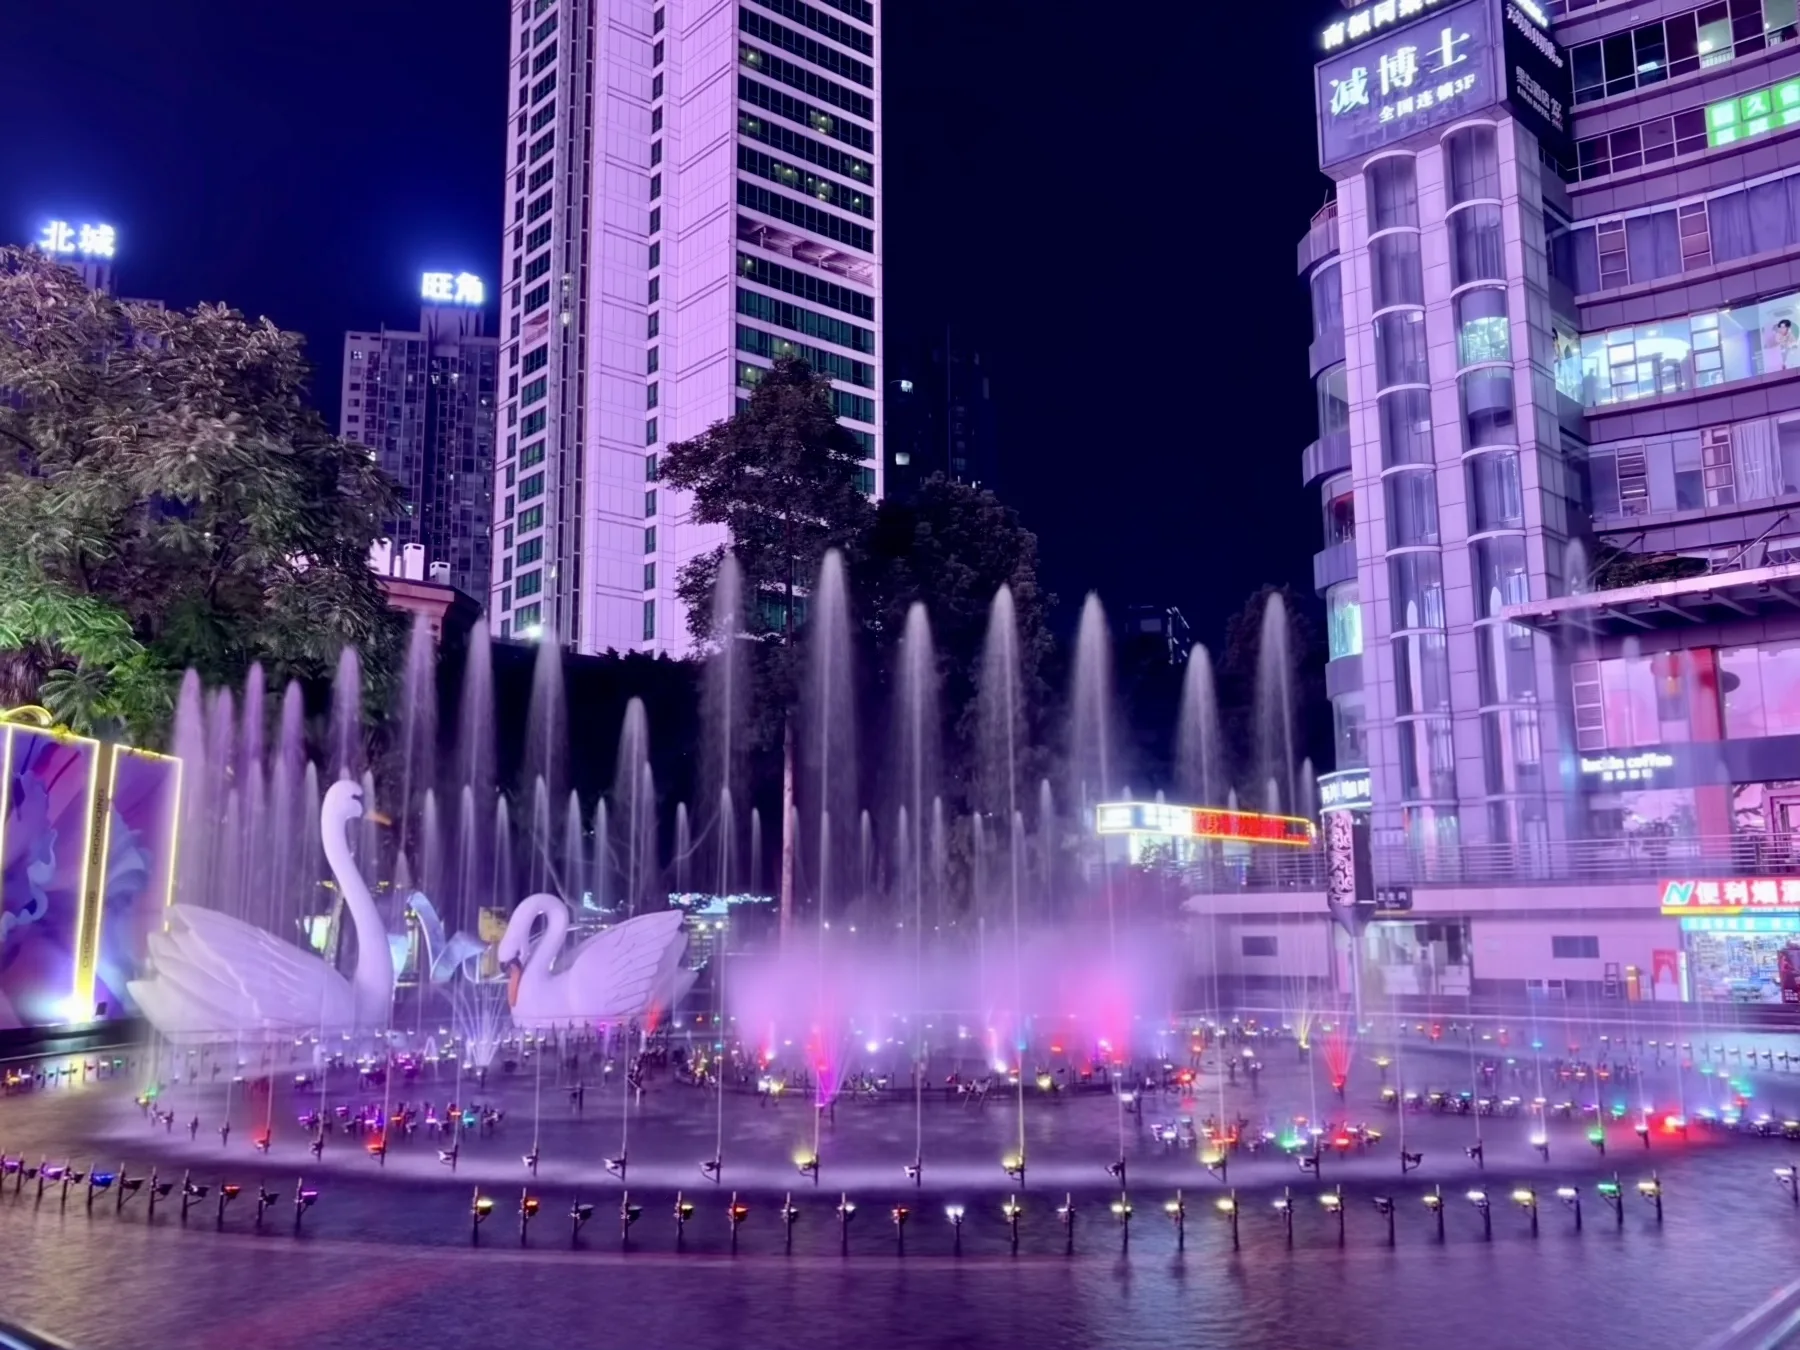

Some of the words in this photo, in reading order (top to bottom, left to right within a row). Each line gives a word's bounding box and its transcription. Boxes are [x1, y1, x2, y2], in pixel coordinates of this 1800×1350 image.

[40, 220, 115, 256] 北城
[422, 272, 484, 305] 旺角
[92, 788, 106, 866] CHONGQING
